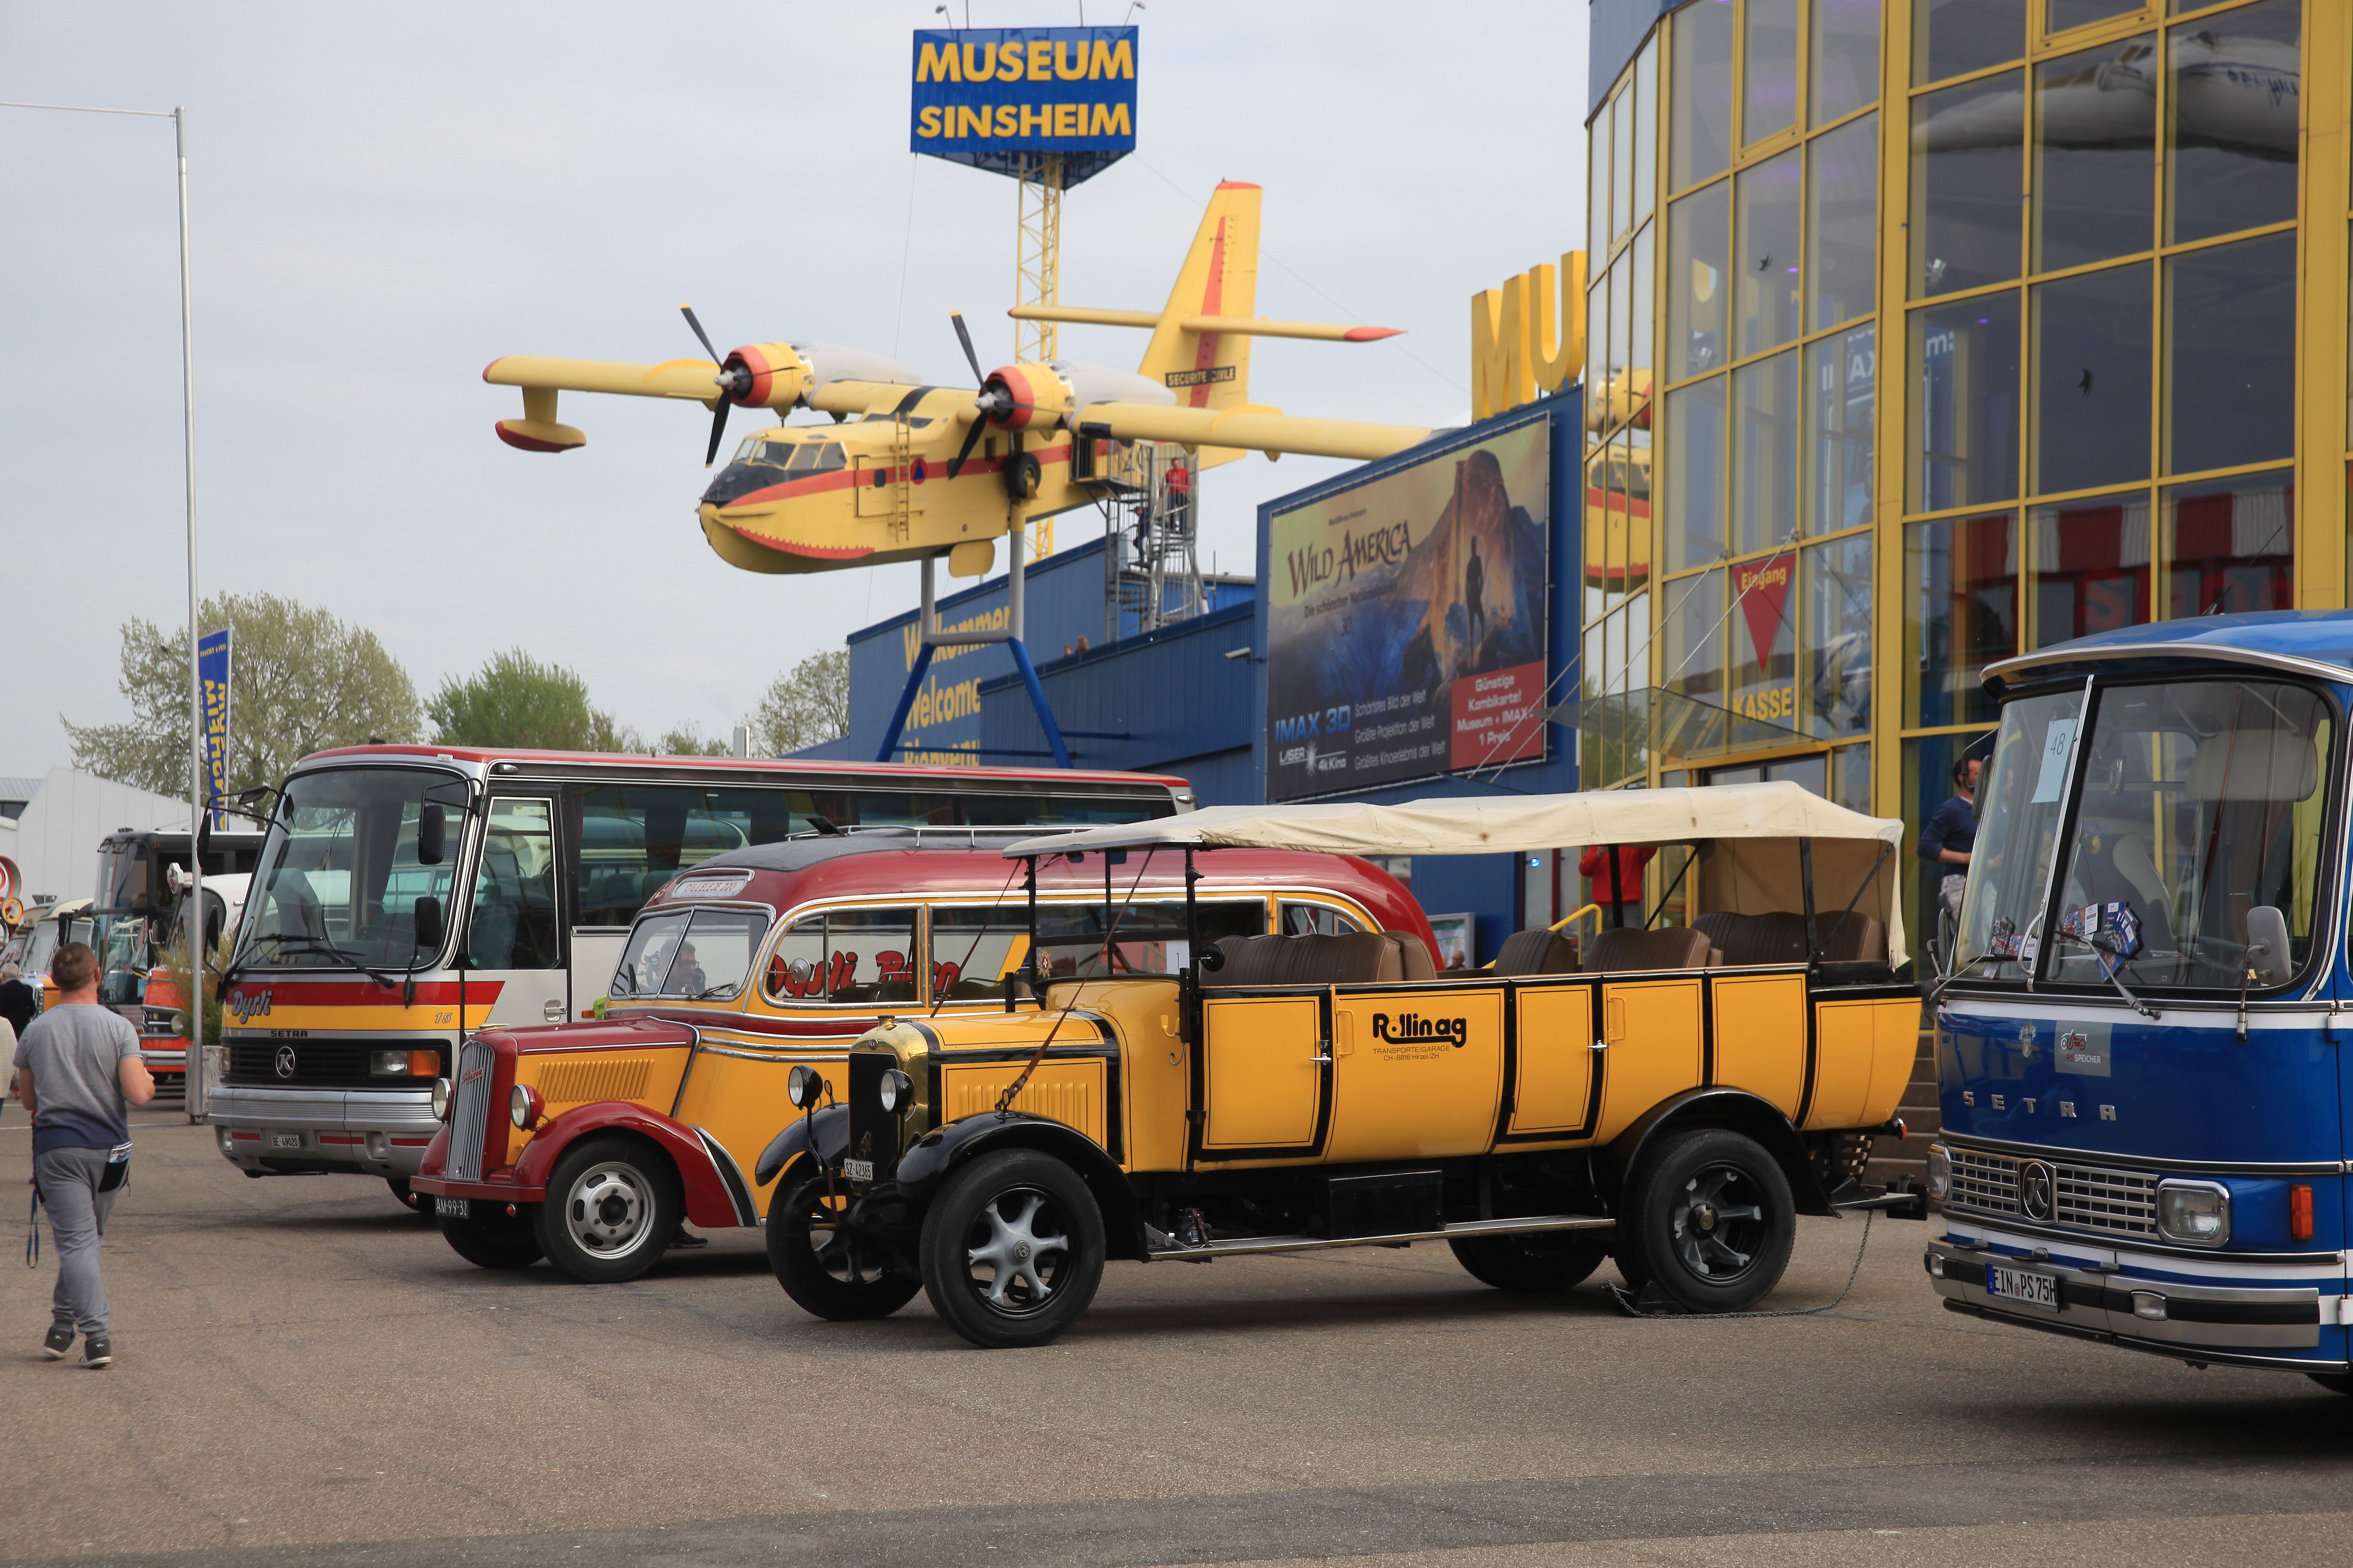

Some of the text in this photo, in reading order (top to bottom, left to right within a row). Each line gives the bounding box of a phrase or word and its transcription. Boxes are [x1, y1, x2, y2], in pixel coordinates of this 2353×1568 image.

[916, 39, 1135, 82] MUSEUM
[916, 103, 1132, 138] SINSHEIM
[1471, 250, 1587, 421] MU
[1741, 567, 1787, 591] Eingang
[1475, 674, 1515, 692] Günstige
[1399, 693, 1411, 708] der
[1468, 689, 1522, 712] Kombikarte!
[1732, 687, 1792, 725] KASSE
[1276, 705, 1352, 745] IMAX 3D
[1409, 719, 1420, 734] der
[1457, 716, 1493, 732] Museum
[1479, 729, 1511, 746] 1 Preis
[2050, 732, 2066, 755] 48
[1279, 746, 1305, 763] LASER
[1418, 743, 1430, 758] der
[231, 989, 273, 1024] Dysli
[435, 1012, 453, 1023] 15
[271, 1030, 308, 1038] SETRA
[1372, 1045, 1450, 1054] TRANSPORTE/GARAGE
[1963, 1091, 2117, 1121] SETRA
[1993, 1268, 2013, 1294] EIN
[2020, 1274, 2034, 1299] PS
[2036, 1277, 2057, 1303] 75H
